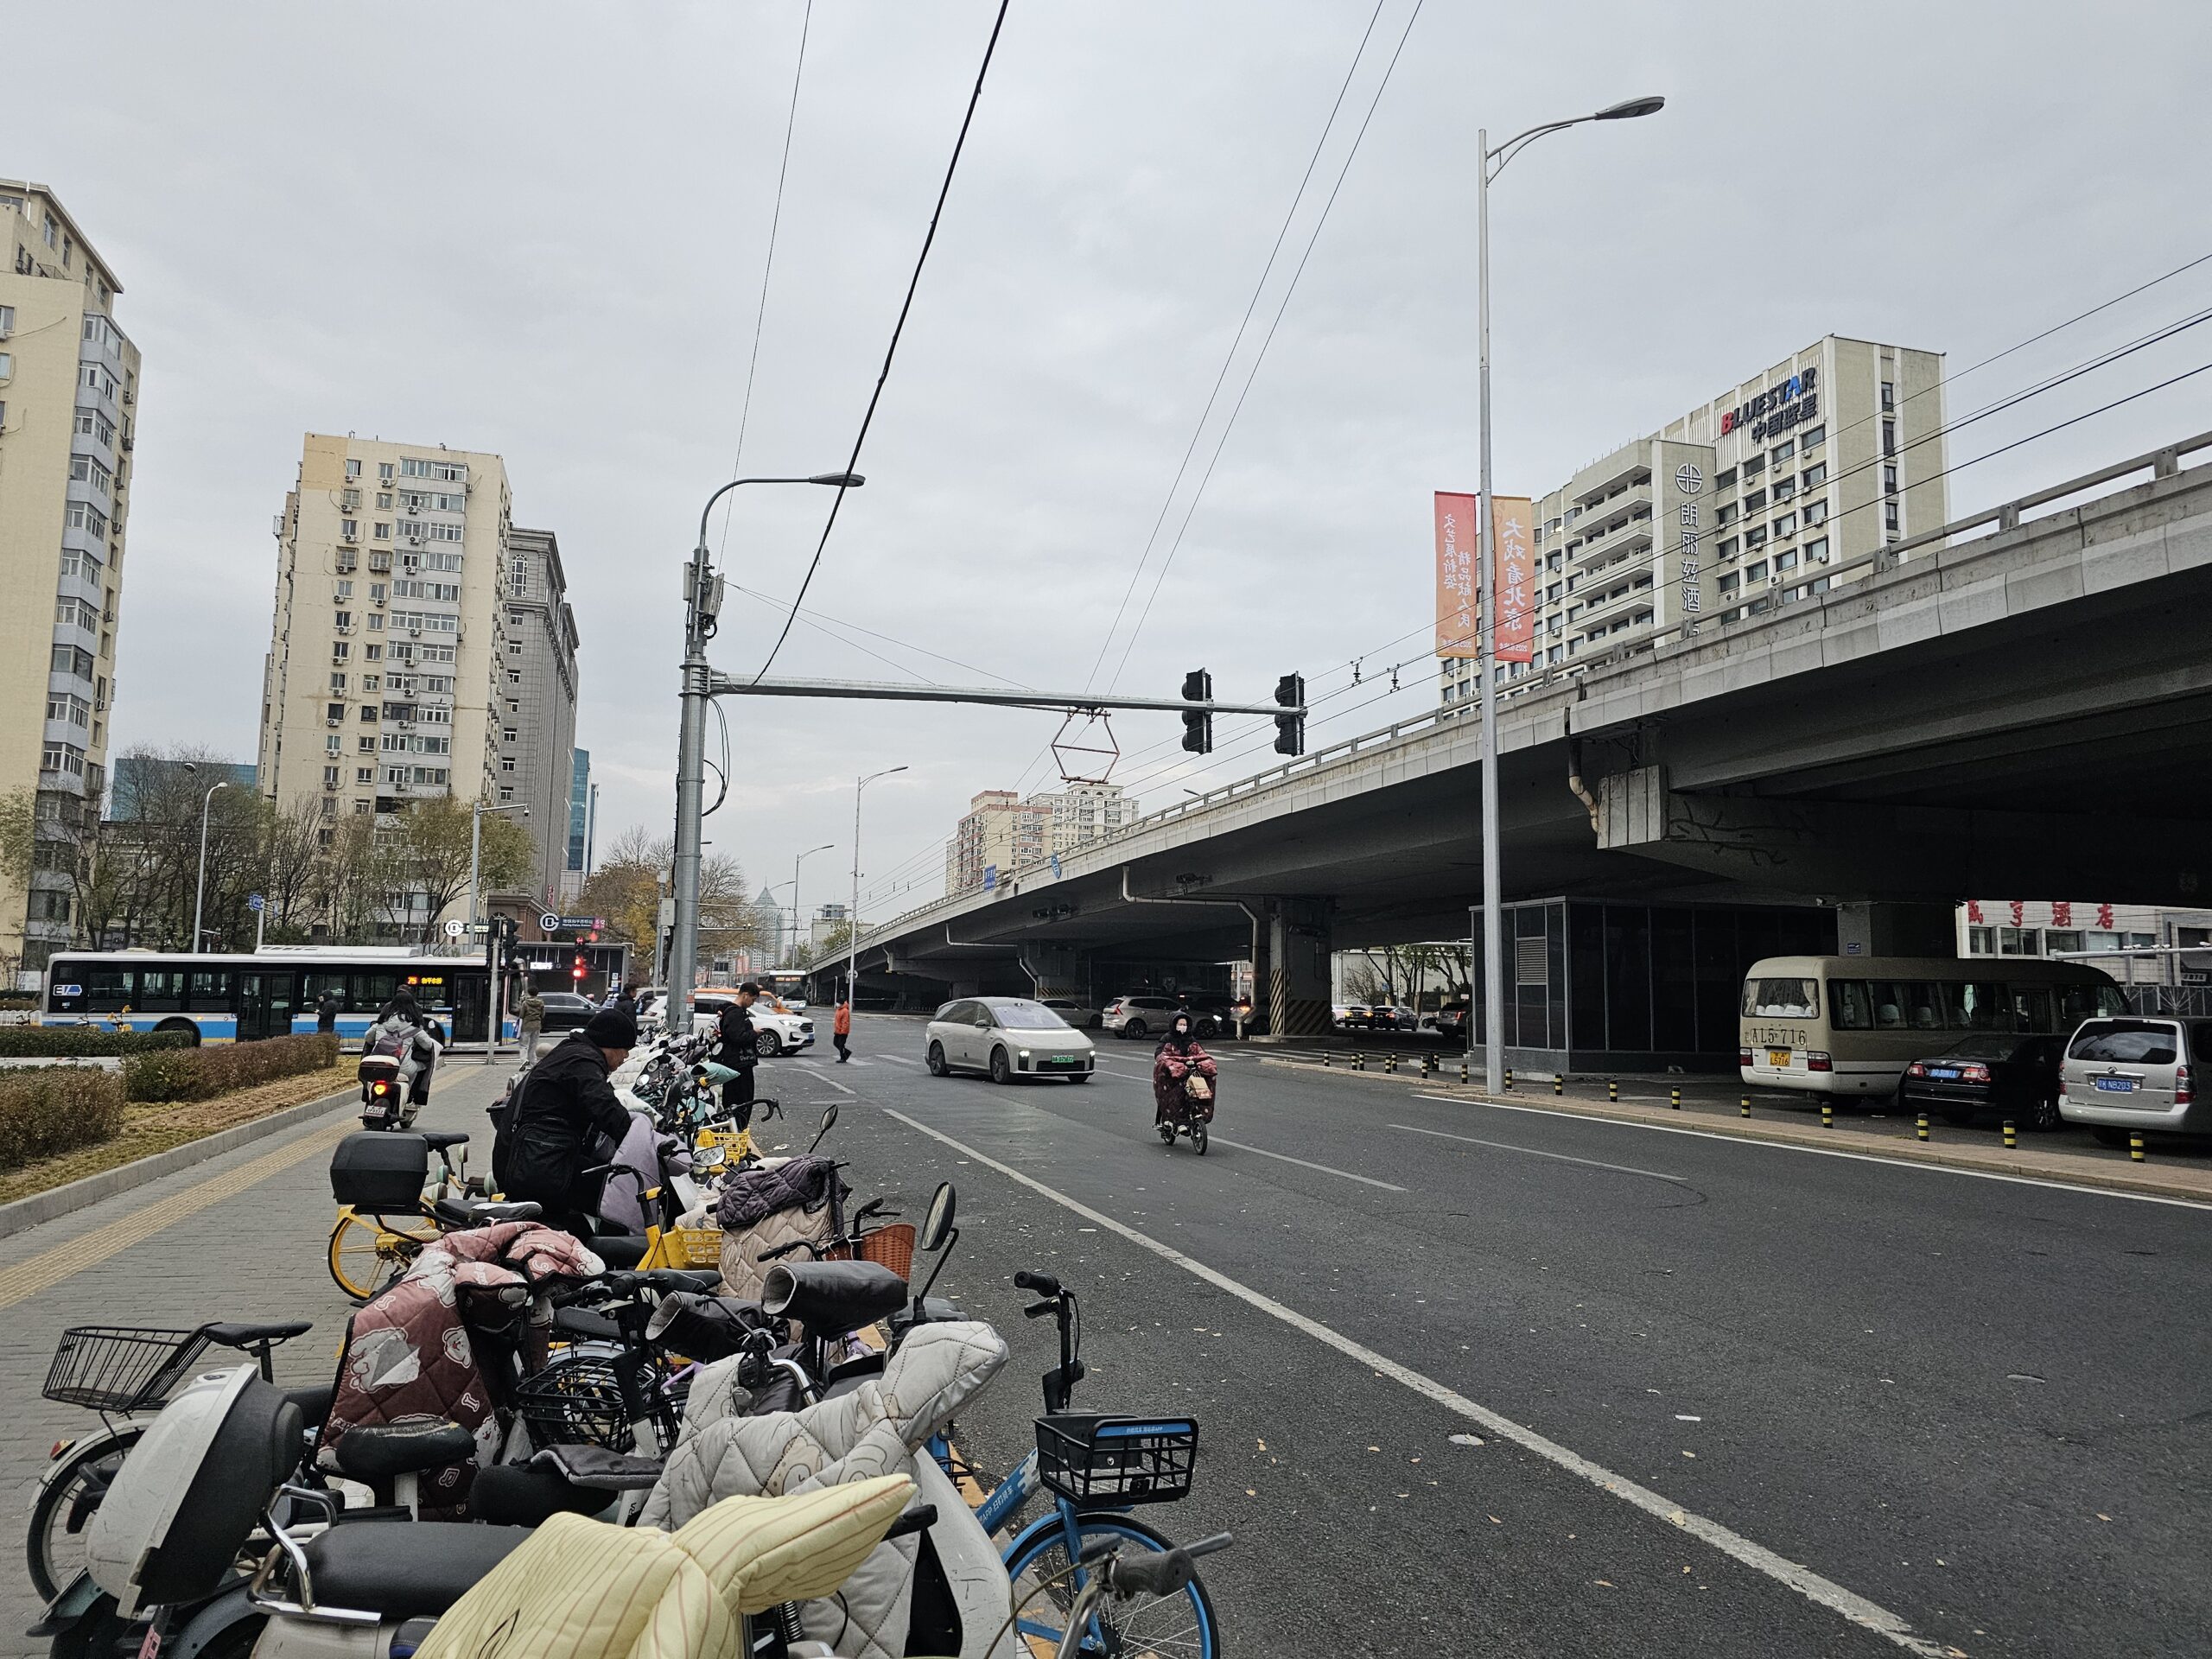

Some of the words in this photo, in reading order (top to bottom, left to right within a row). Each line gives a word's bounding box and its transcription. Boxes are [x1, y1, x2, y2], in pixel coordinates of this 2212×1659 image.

[1721, 367, 1815, 435] BLUESTAR
[1751, 393, 1816, 443] 中国蓝星
